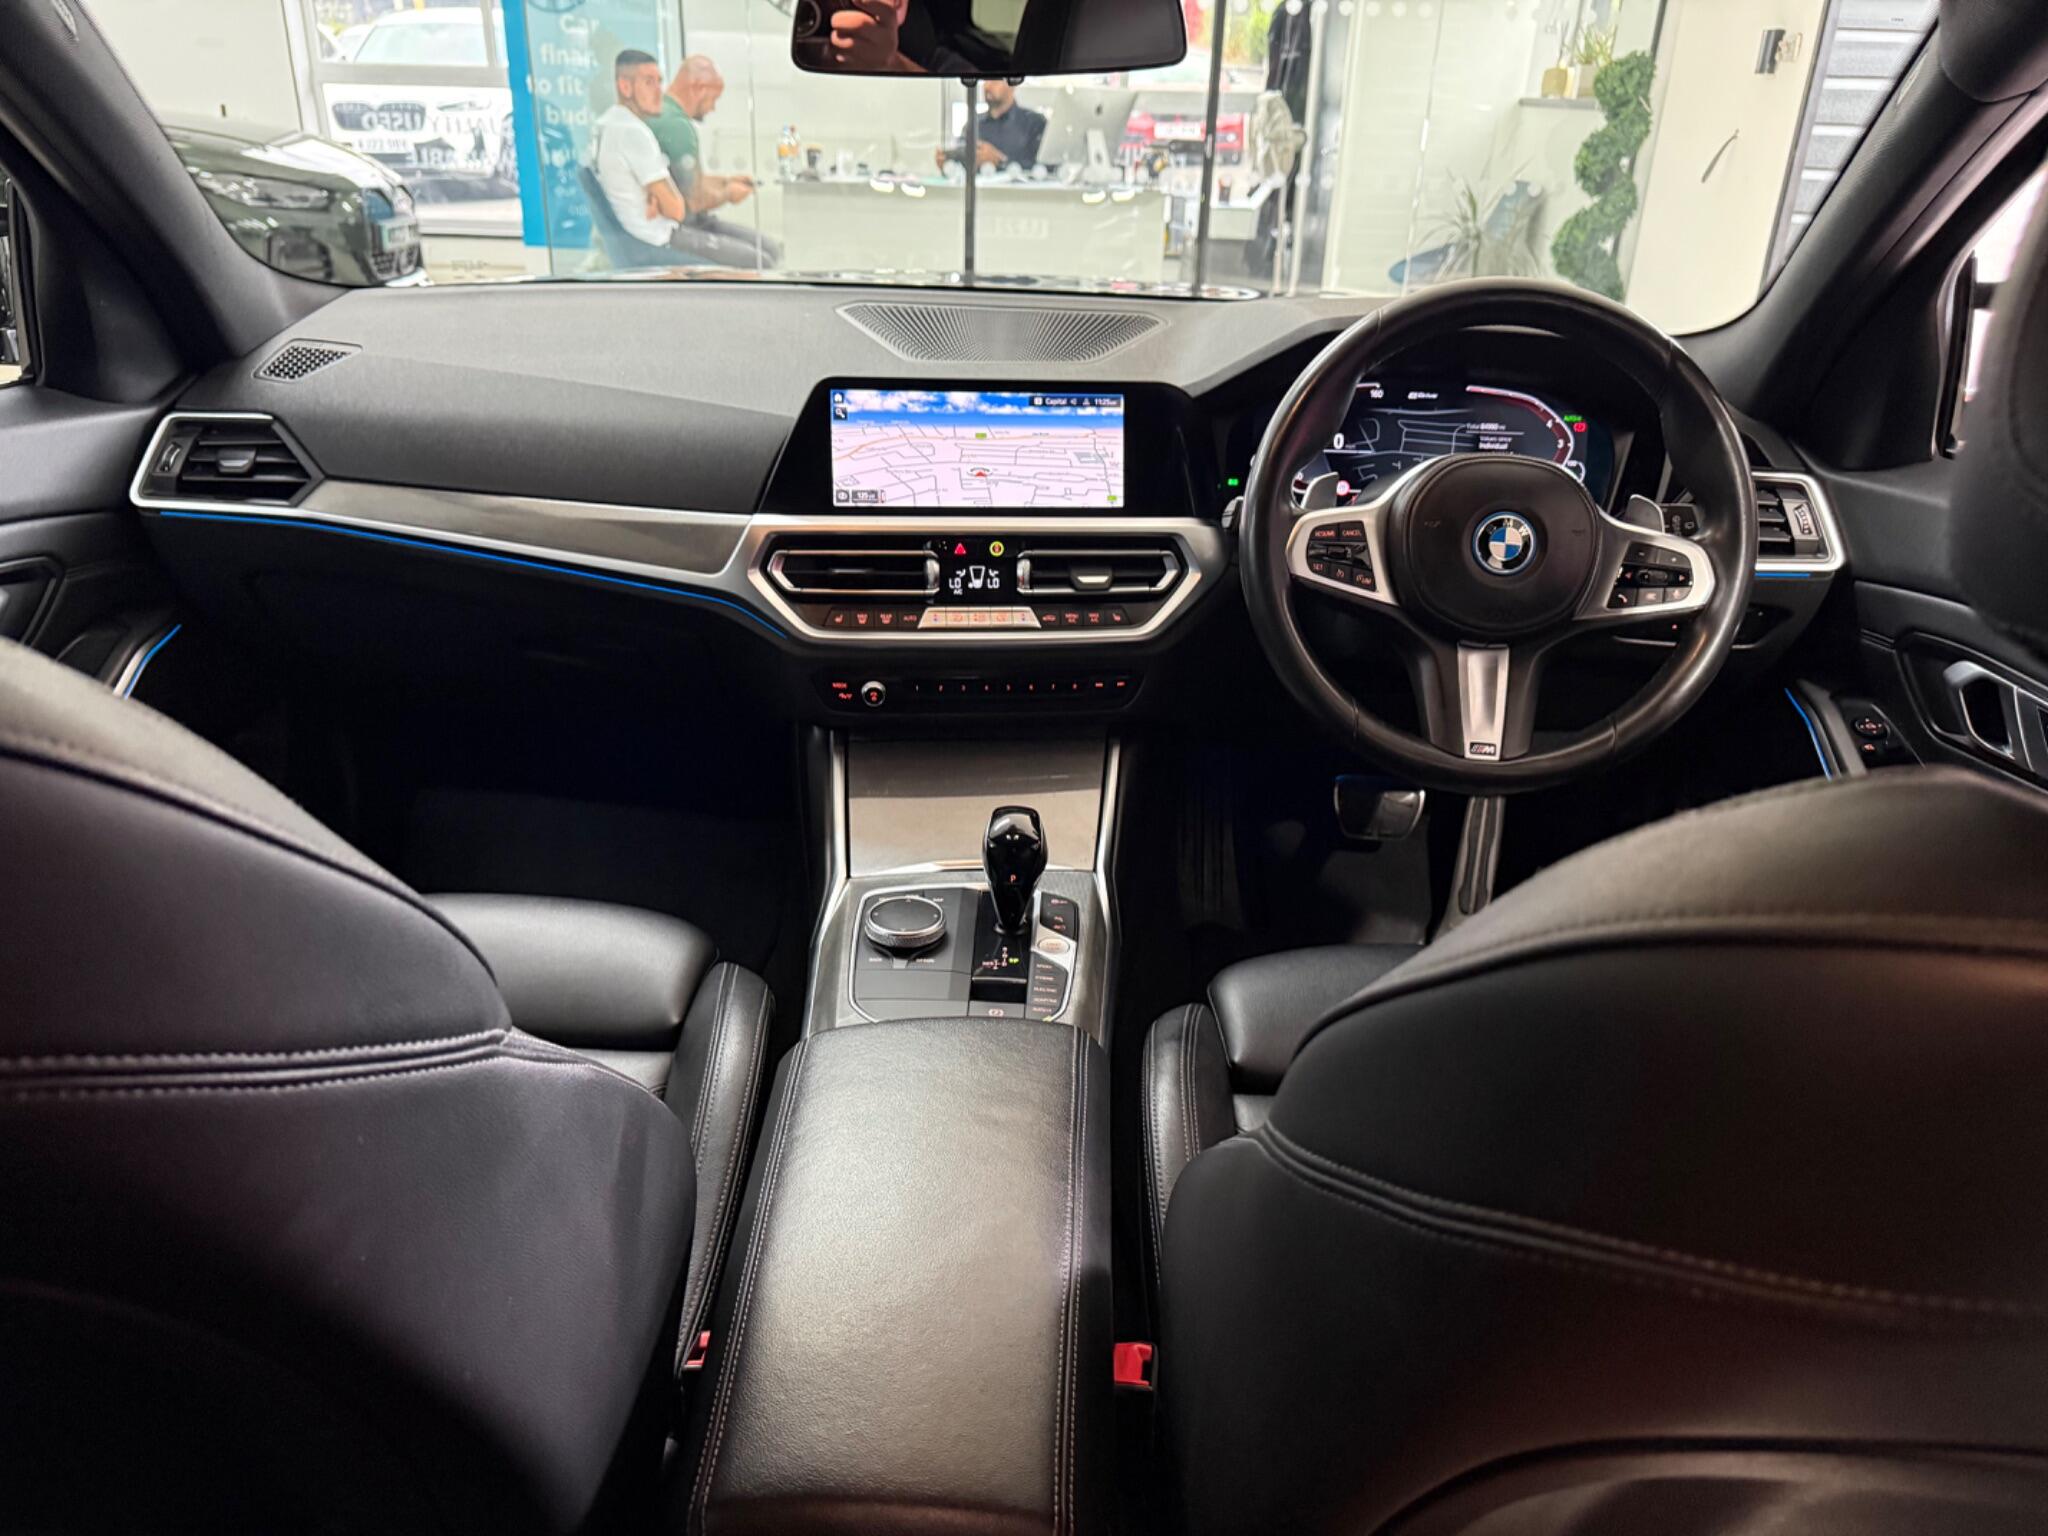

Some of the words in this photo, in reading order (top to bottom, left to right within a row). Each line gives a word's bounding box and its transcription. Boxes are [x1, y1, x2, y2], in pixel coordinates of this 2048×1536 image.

[559, 75, 583, 96] fit
[1045, 397, 1067, 406] Capital
[1334, 433, 1345, 449] 0
[1010, 874, 1017, 884] P
